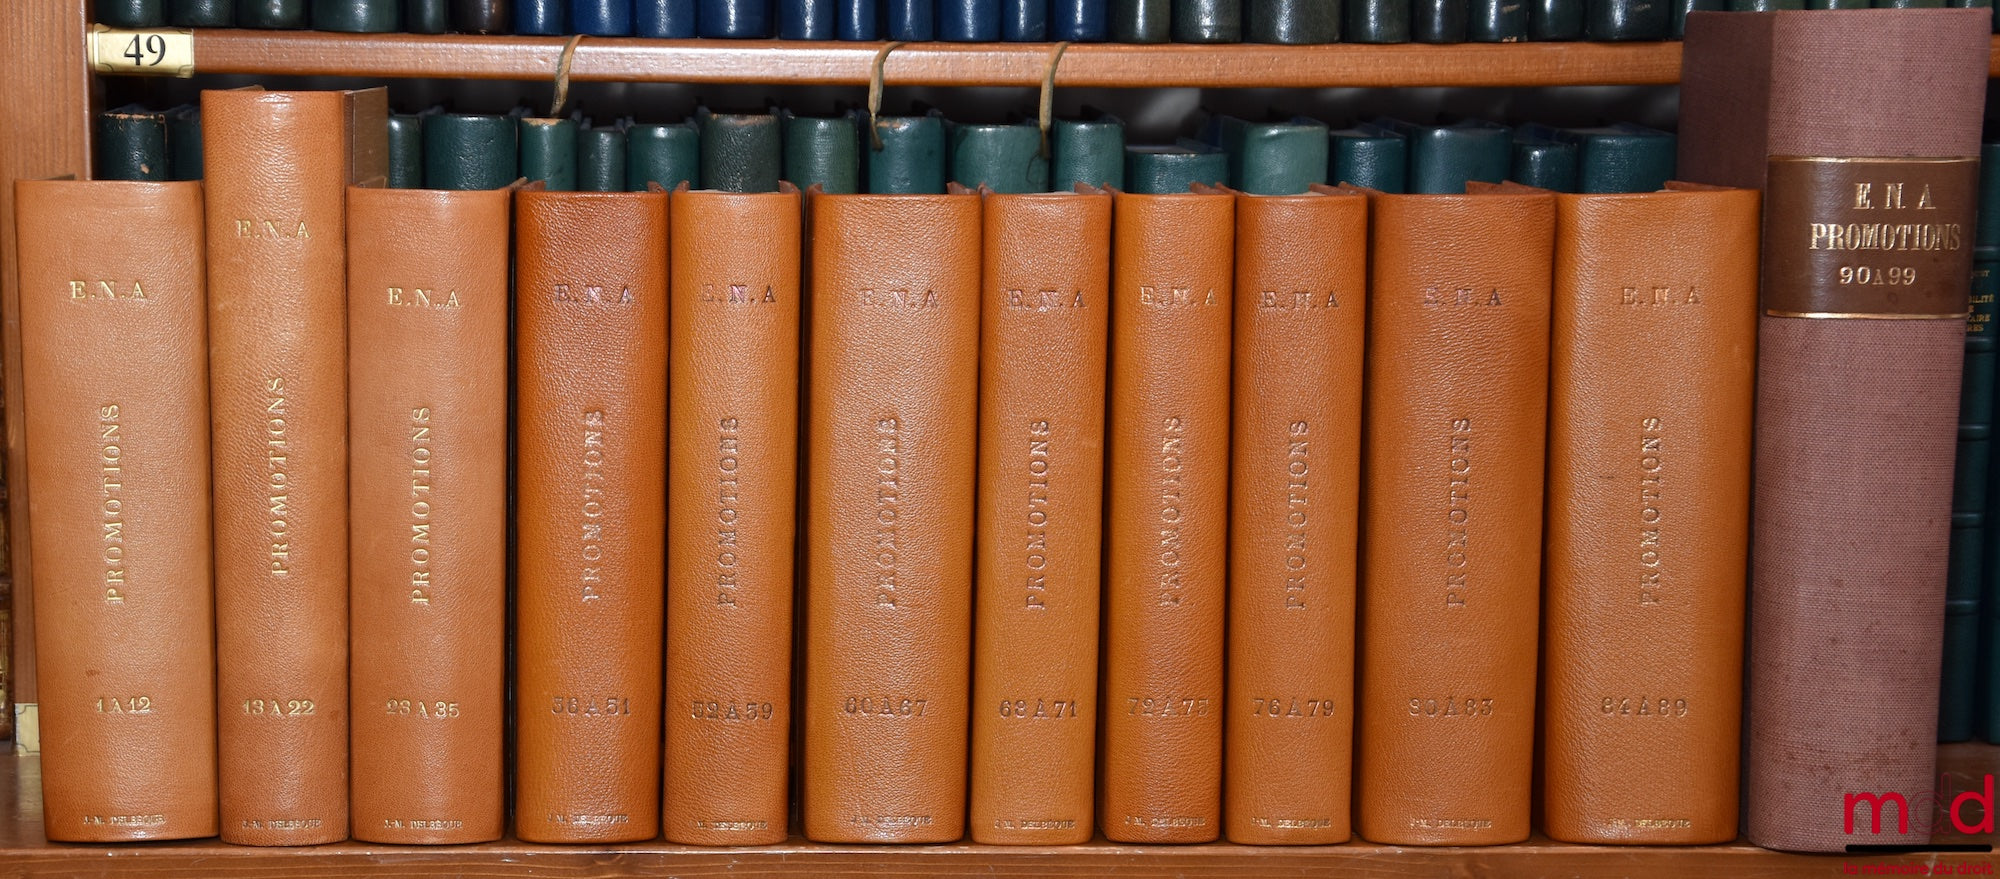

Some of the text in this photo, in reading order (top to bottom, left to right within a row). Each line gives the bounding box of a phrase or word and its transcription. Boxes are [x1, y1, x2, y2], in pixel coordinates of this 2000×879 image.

[124, 34, 166, 66] 49
[1809, 223, 1960, 250] PROMOTIONS
[101, 402, 124, 604] PROMOTIONS
[267, 377, 289, 576] PROMOTIONS
[411, 405, 432, 605] PROMOTIONS
[581, 409, 603, 602] PROMOTIONS
[717, 417, 739, 609] PROMOTIONS
[875, 418, 898, 610] PROMOTIONS
[1025, 420, 1049, 611] PROMOTIONS
[1159, 417, 1182, 607] PROMOTIONS
[1285, 420, 1309, 610] PROMOTIONS
[1446, 418, 1470, 608] PROMOTIONS
[1641, 417, 1662, 607] PROMOTIONS
